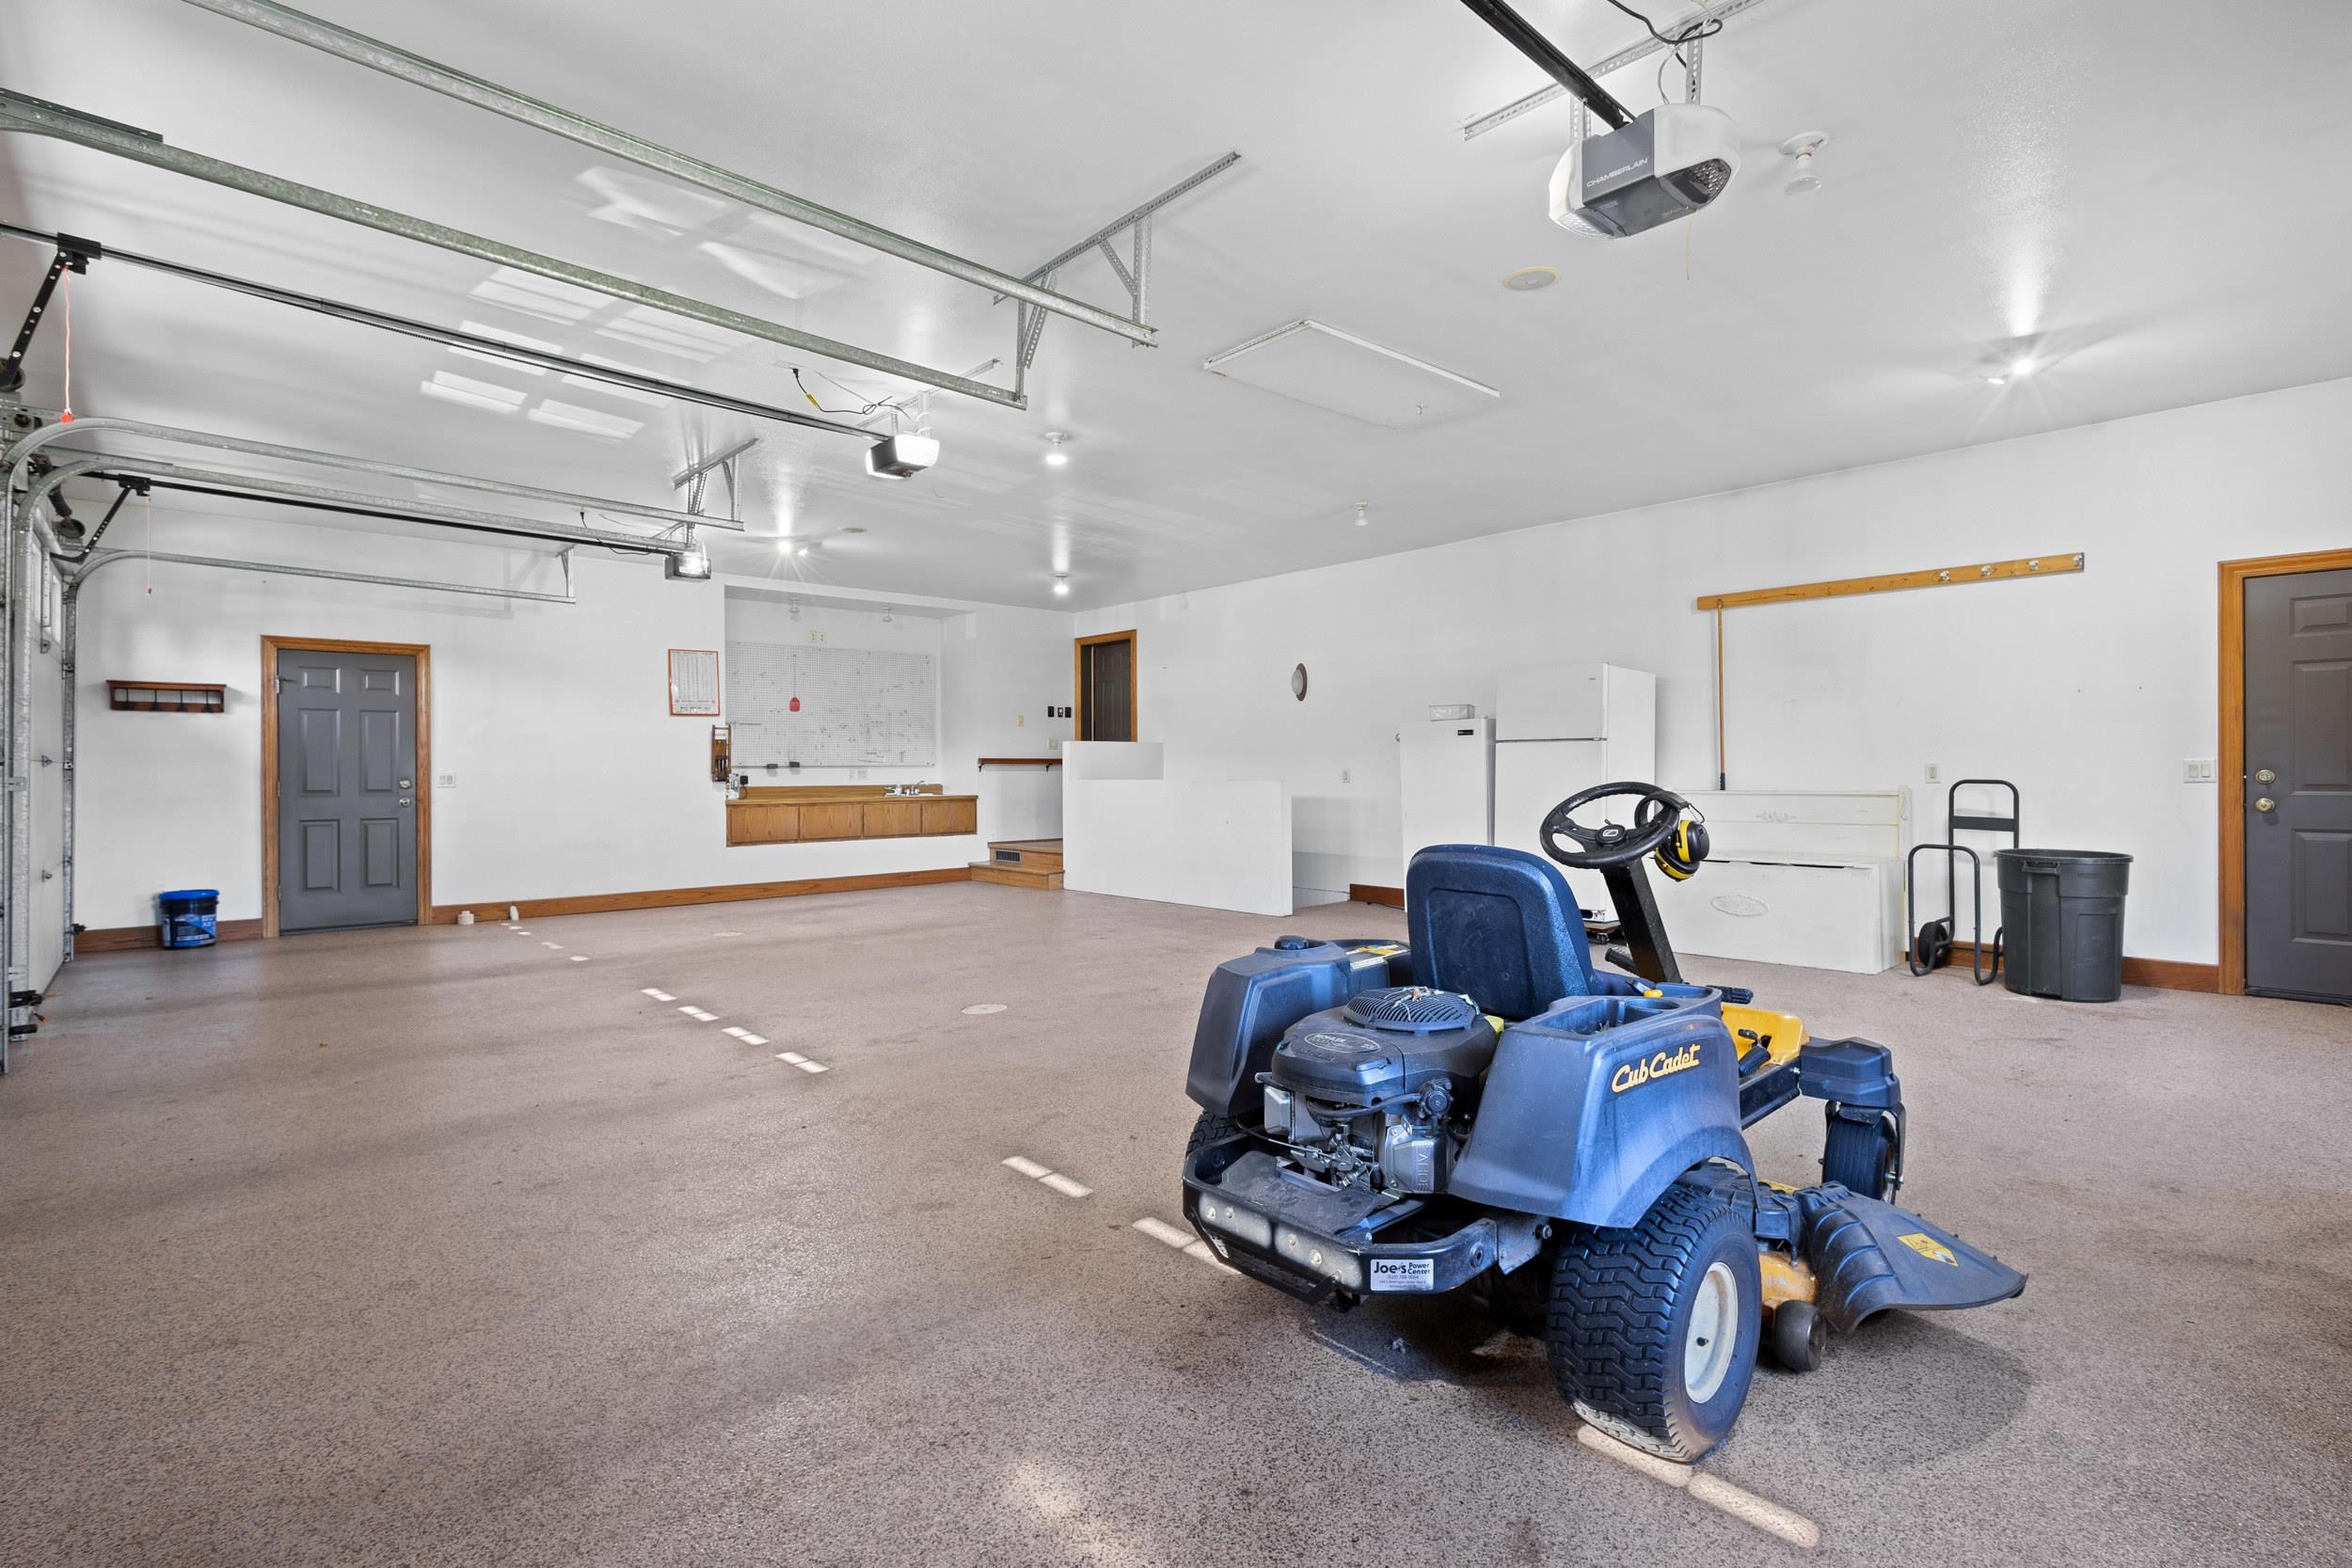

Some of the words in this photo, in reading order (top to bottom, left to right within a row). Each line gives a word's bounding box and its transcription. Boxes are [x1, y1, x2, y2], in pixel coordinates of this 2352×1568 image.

[1586, 157, 1648, 187] CHAMBERLAIN
[1612, 1058, 1649, 1093] Cub
[1649, 1043, 1701, 1079] Cadet
[1374, 1261, 1406, 1274] Joe's
